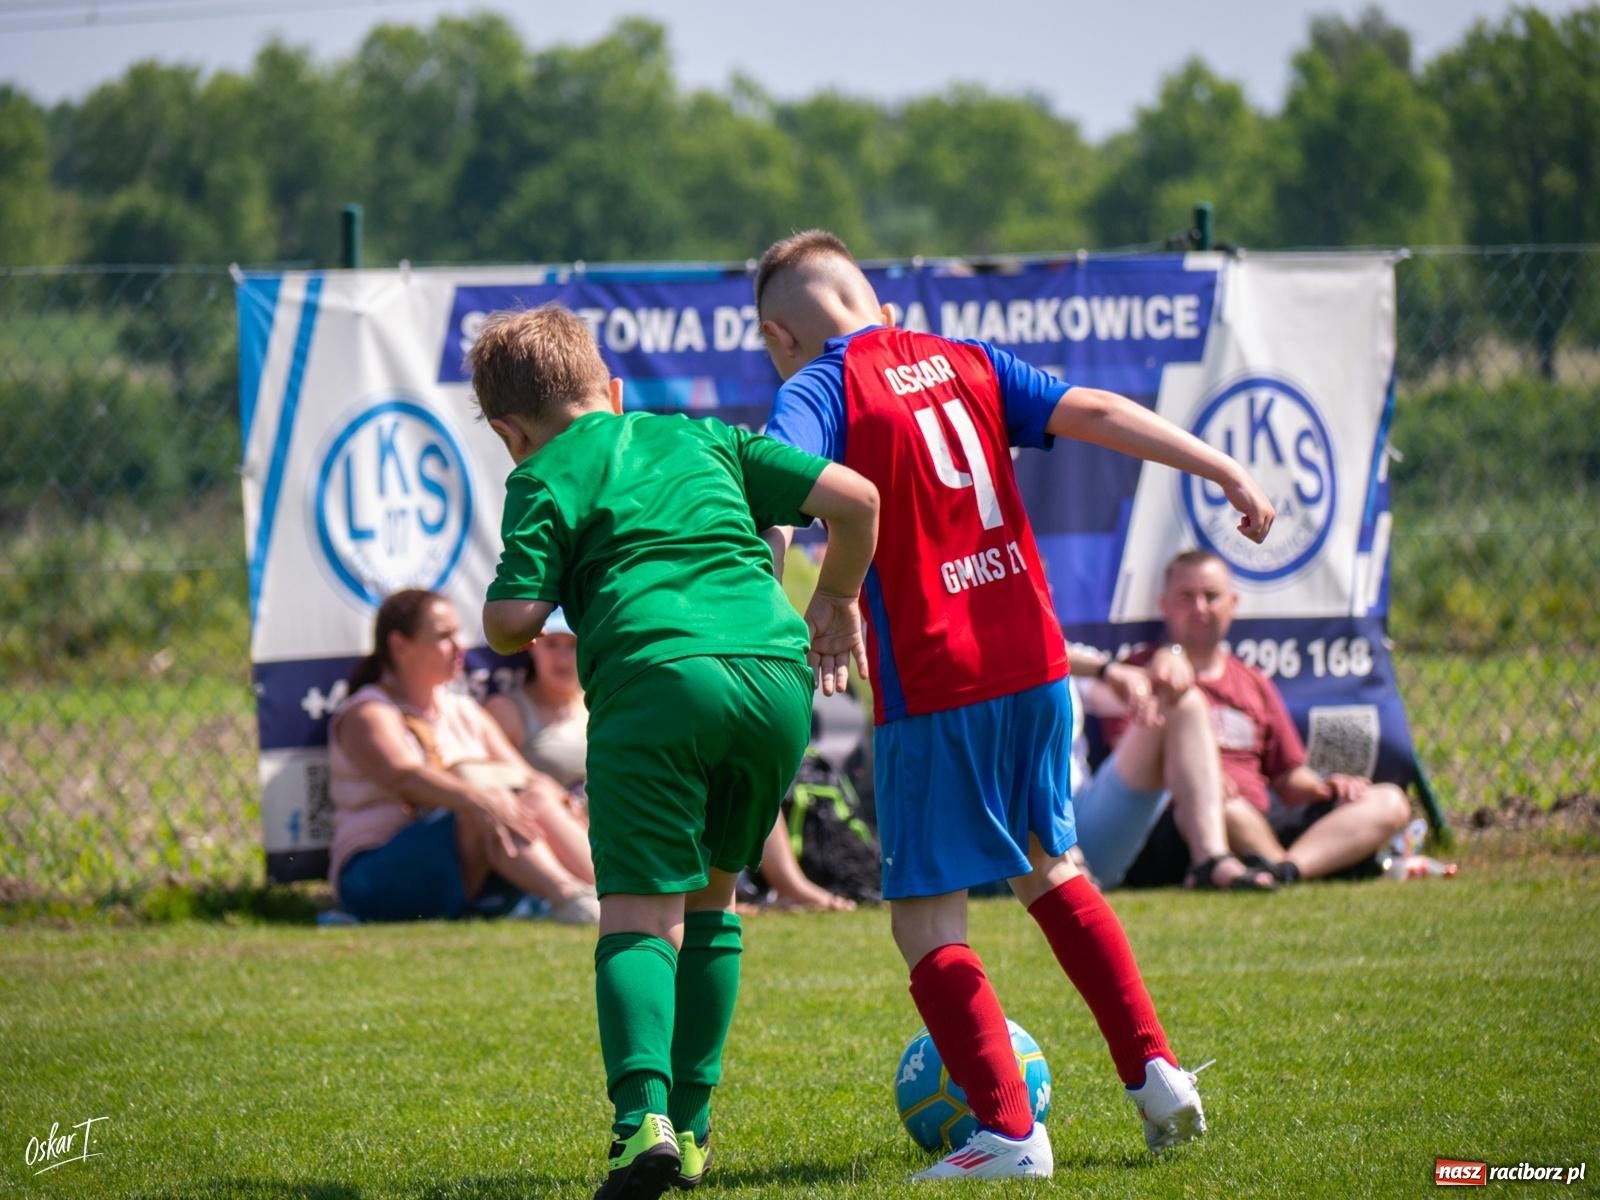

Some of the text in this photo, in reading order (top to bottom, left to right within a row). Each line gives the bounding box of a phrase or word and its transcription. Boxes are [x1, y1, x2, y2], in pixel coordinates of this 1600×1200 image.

[459, 306, 707, 353] STOWA
[940, 295, 1200, 343] MARKOWICE
[884, 354, 956, 395] OSKAR
[343, 418, 450, 541] LKS
[914, 398, 1004, 530] 4
[941, 547, 1006, 594] GMKS
[1307, 636, 1373, 677] 168
